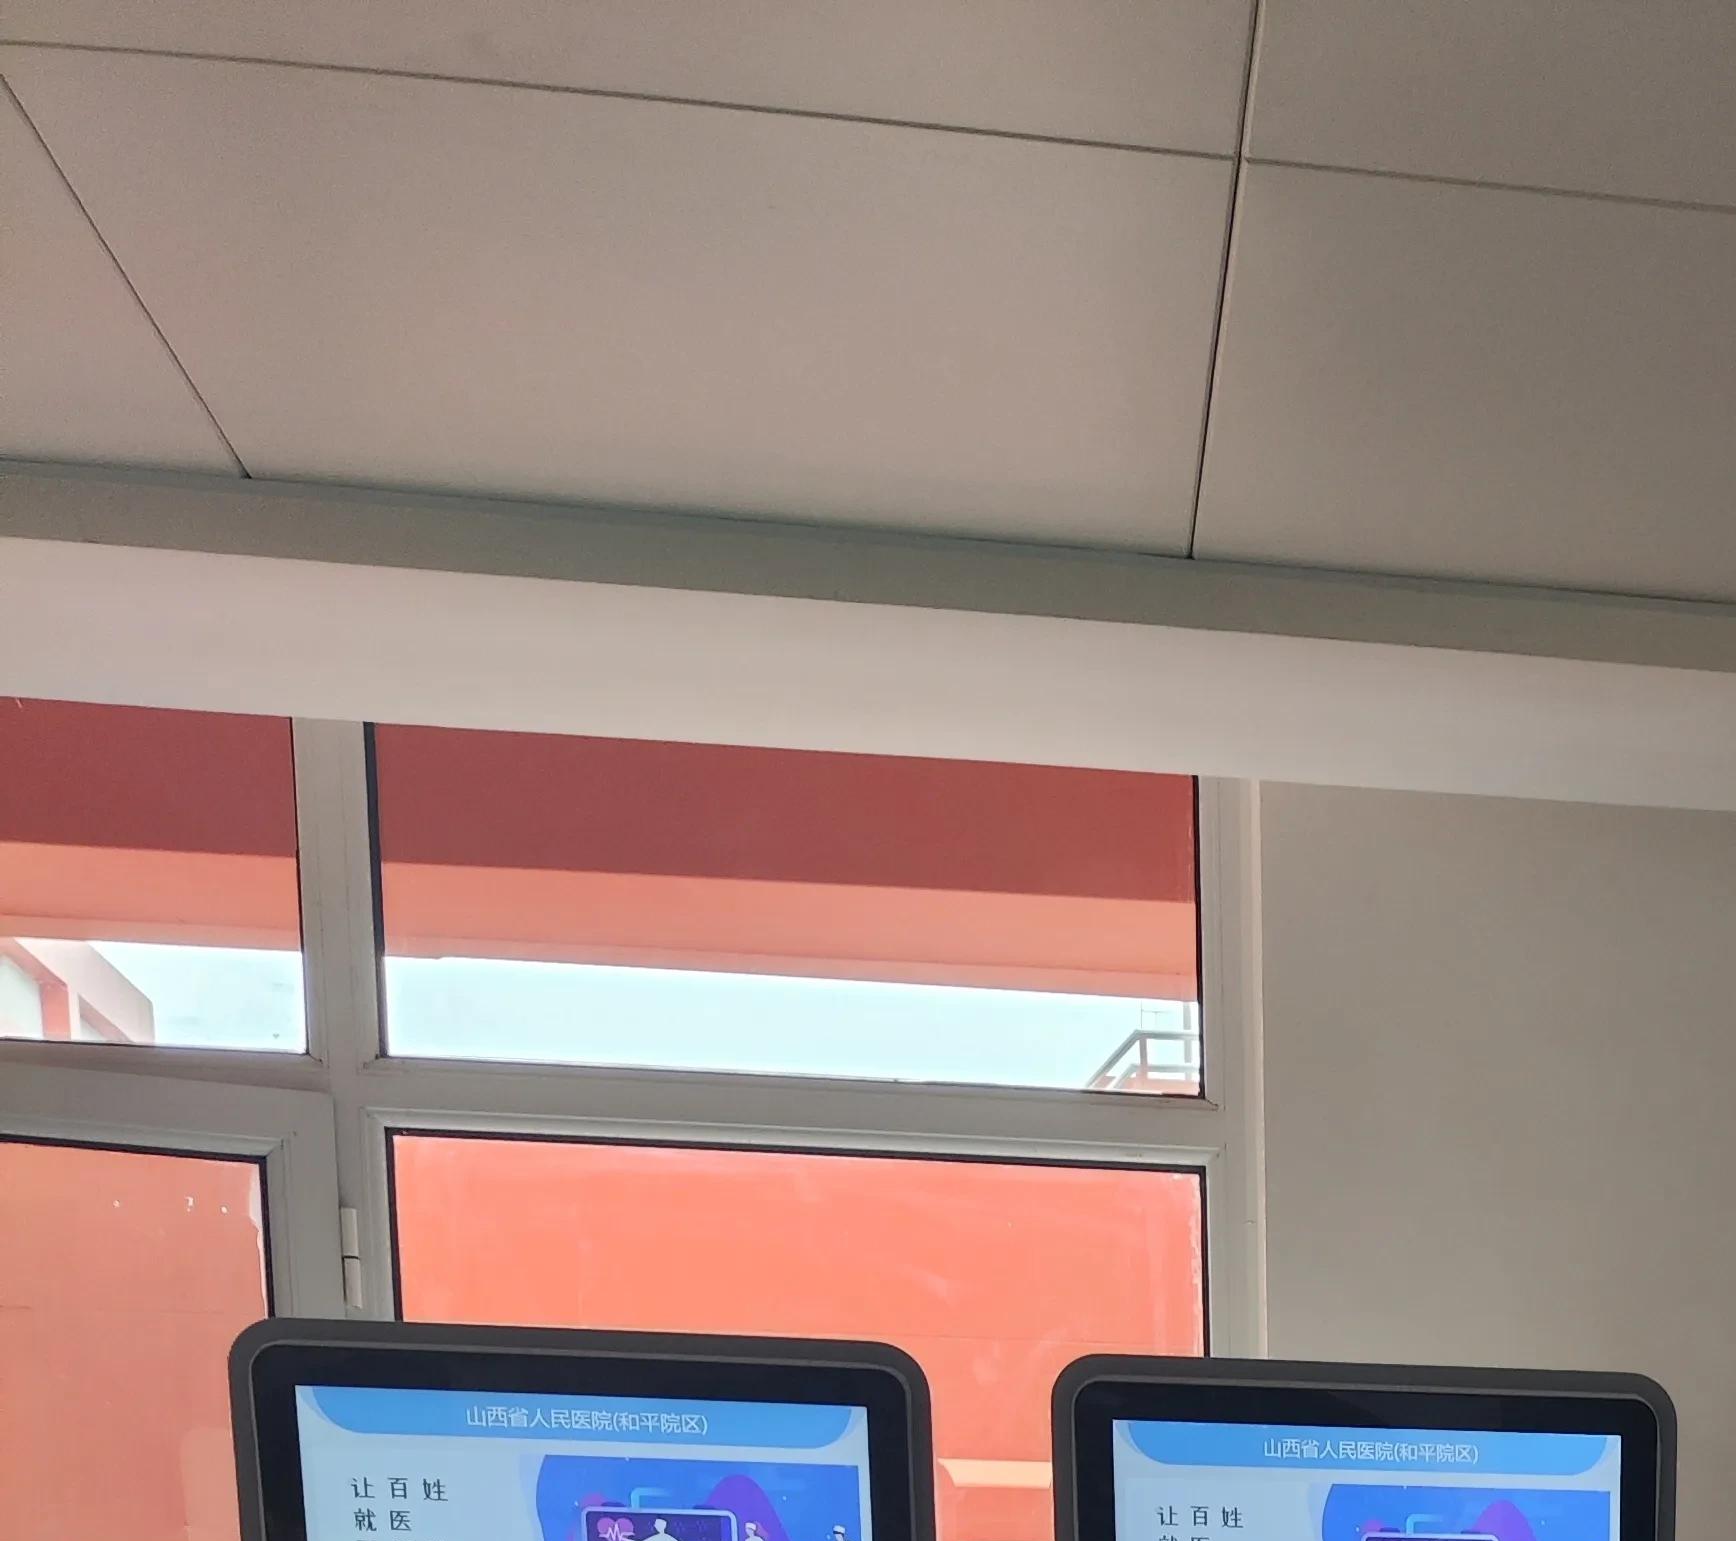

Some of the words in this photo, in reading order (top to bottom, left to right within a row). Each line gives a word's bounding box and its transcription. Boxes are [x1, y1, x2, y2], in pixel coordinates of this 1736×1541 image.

[466, 1405, 709, 1435] 山西省人民医院(和平院区)
[1264, 1438, 1479, 1465] 山西省人民医院(和平院区)
[351, 1477, 448, 1501] 让百姓
[354, 1508, 412, 1531] 就医
[1156, 1506, 1244, 1529] 让百姓
